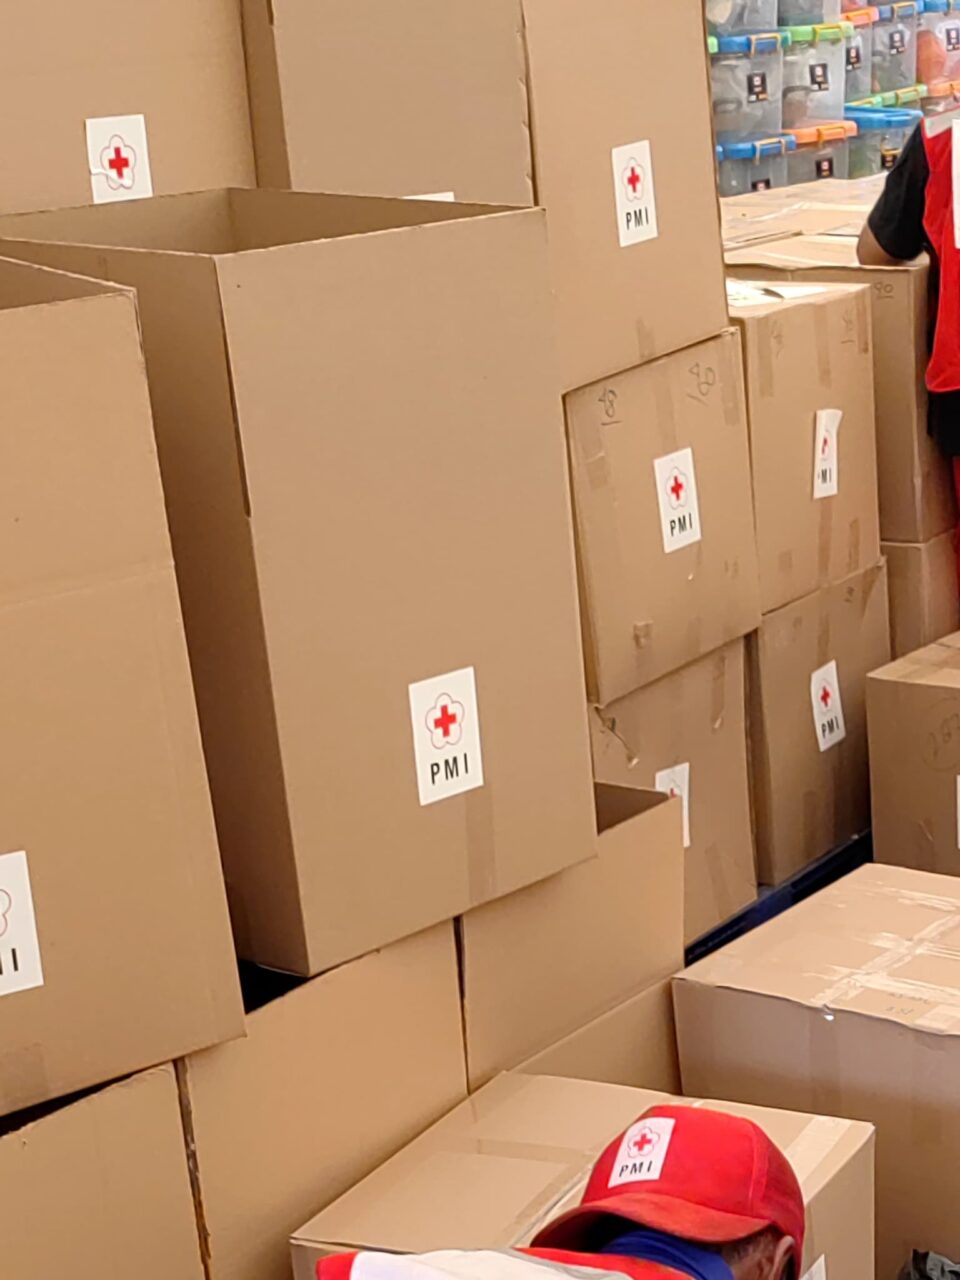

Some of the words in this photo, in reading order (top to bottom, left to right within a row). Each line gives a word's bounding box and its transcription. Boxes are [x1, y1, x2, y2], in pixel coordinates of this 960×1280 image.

[625, 206, 649, 230] PMI
[817, 467, 832, 485] MI
[669, 512, 693, 537] PMI
[821, 715, 840, 739] PMI
[429, 752, 469, 785] PMI
[619, 1160, 653, 1178] PMI
